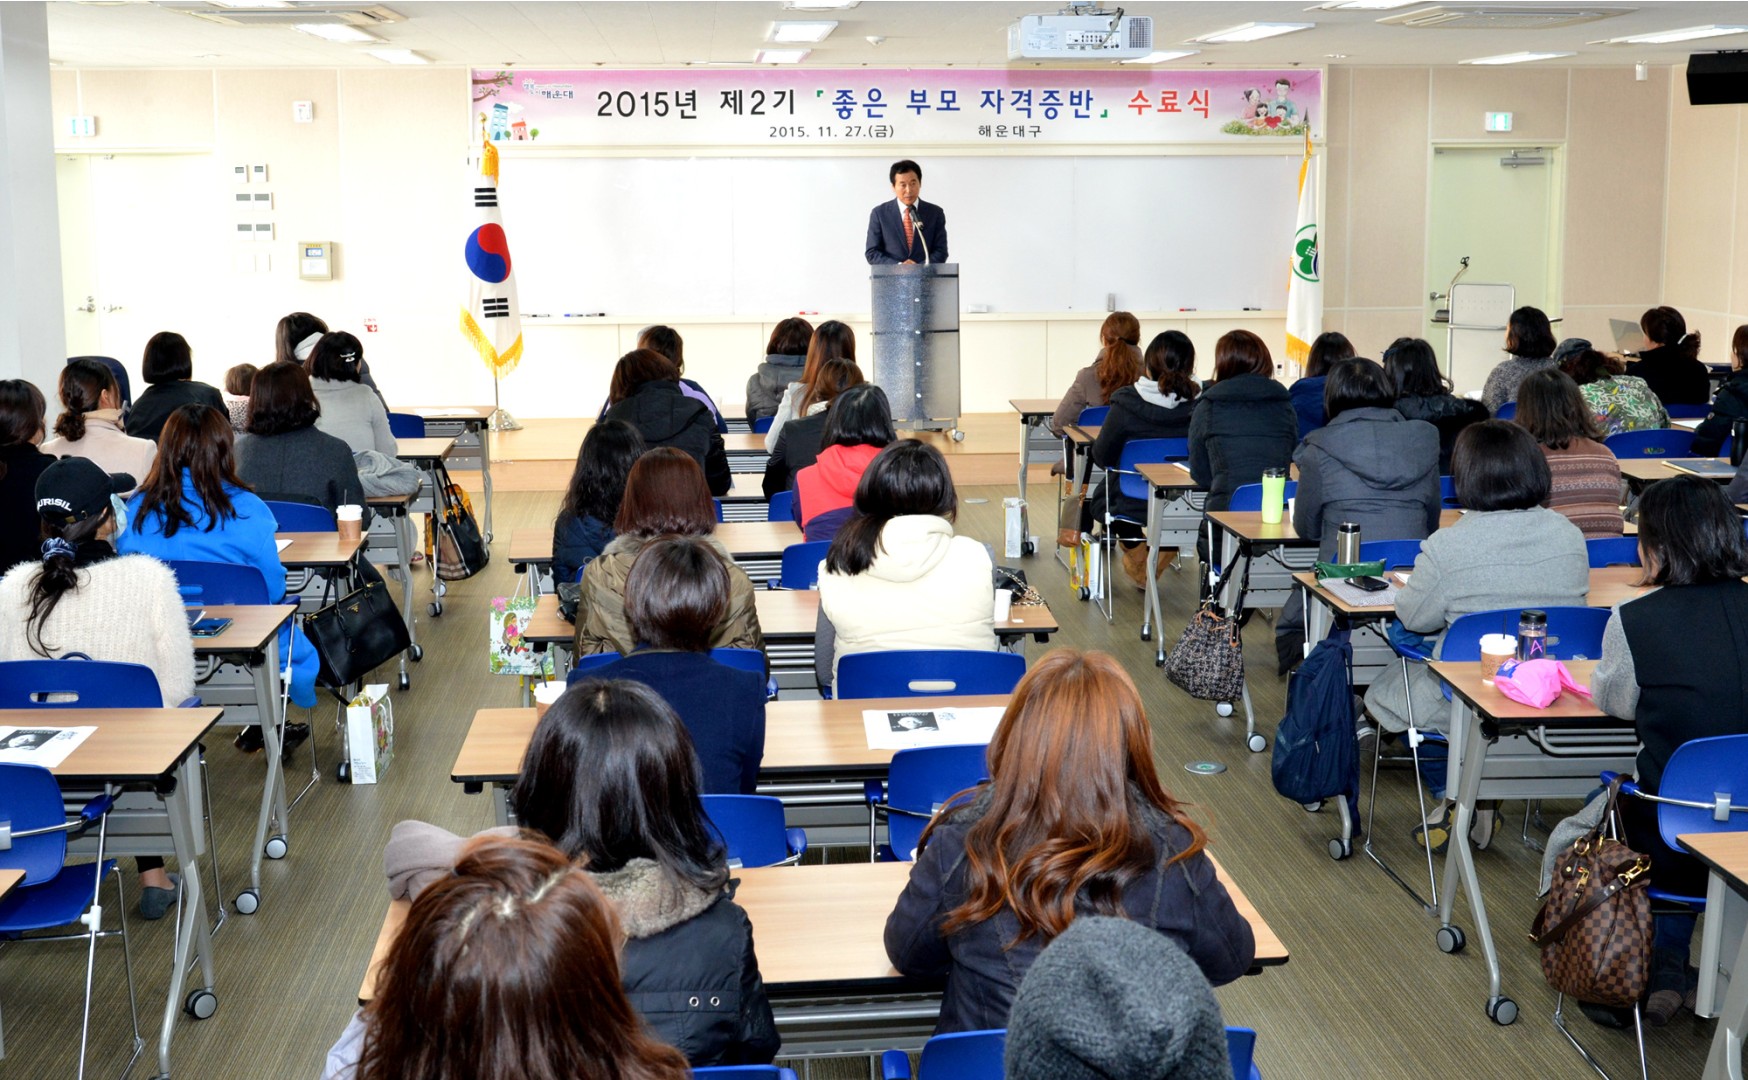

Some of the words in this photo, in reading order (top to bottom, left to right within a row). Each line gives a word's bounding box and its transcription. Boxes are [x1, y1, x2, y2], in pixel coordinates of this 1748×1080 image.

[597, 89, 698, 119] 2015년
[719, 89, 794, 116] 제2기
[905, 89, 961, 116] 부모
[1127, 89, 1210, 120] 수료식
[769, 126, 809, 138] 2015.
[818, 126, 837, 138] 11.
[845, 124, 894, 139] 27.(금)
[978, 124, 1042, 138] 해운대구
